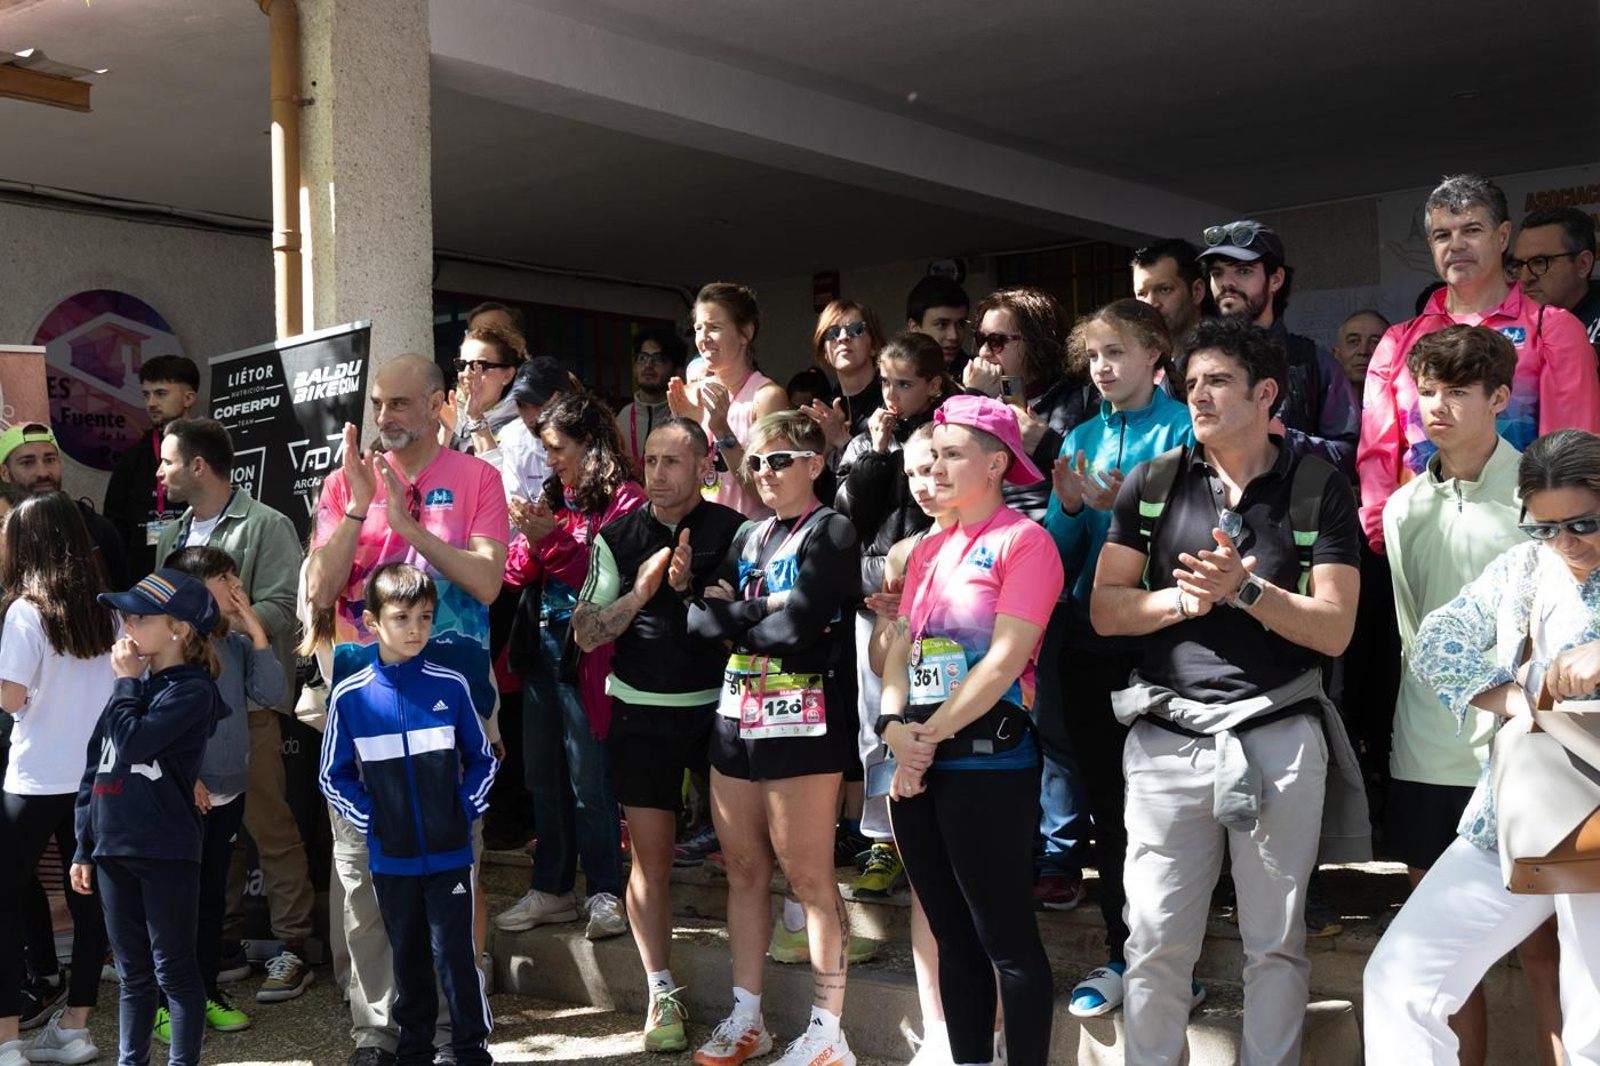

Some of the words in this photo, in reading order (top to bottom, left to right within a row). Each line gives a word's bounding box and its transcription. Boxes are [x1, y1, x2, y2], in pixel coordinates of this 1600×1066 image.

[228, 365, 273, 387] LIÉTOR
[293, 360, 362, 388] BALDU
[293, 376, 360, 404] BIKE.COM
[61, 407, 126, 428] Fuente
[214, 395, 280, 420] COFERPU
[99, 430, 112, 440] de
[117, 430, 126, 440] la
[914, 667, 939, 687] 361
